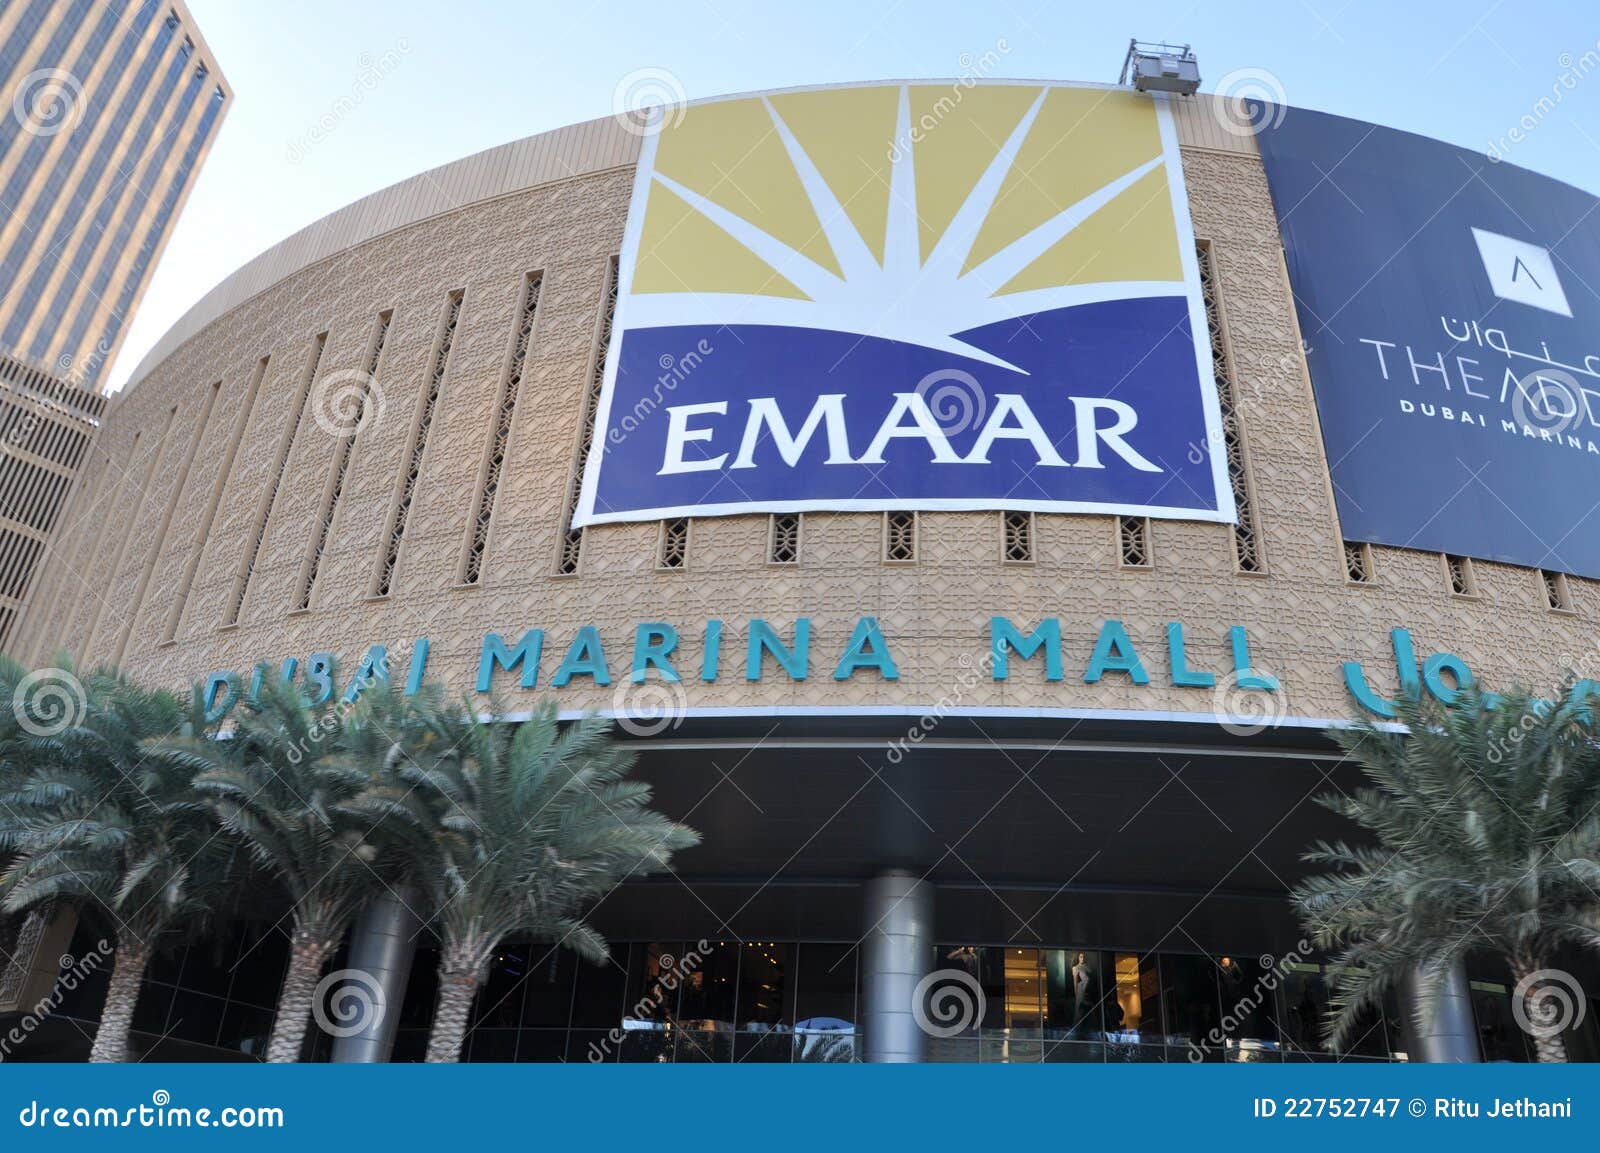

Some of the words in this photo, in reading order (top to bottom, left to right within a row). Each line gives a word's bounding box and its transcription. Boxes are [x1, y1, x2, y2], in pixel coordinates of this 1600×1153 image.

[656, 393, 1165, 476] EMAAR
[1400, 399, 1486, 427] DUBAI
[1501, 419, 1600, 455] MARINA
[476, 616, 899, 693] MARINA
[991, 615, 1281, 691] MALL
